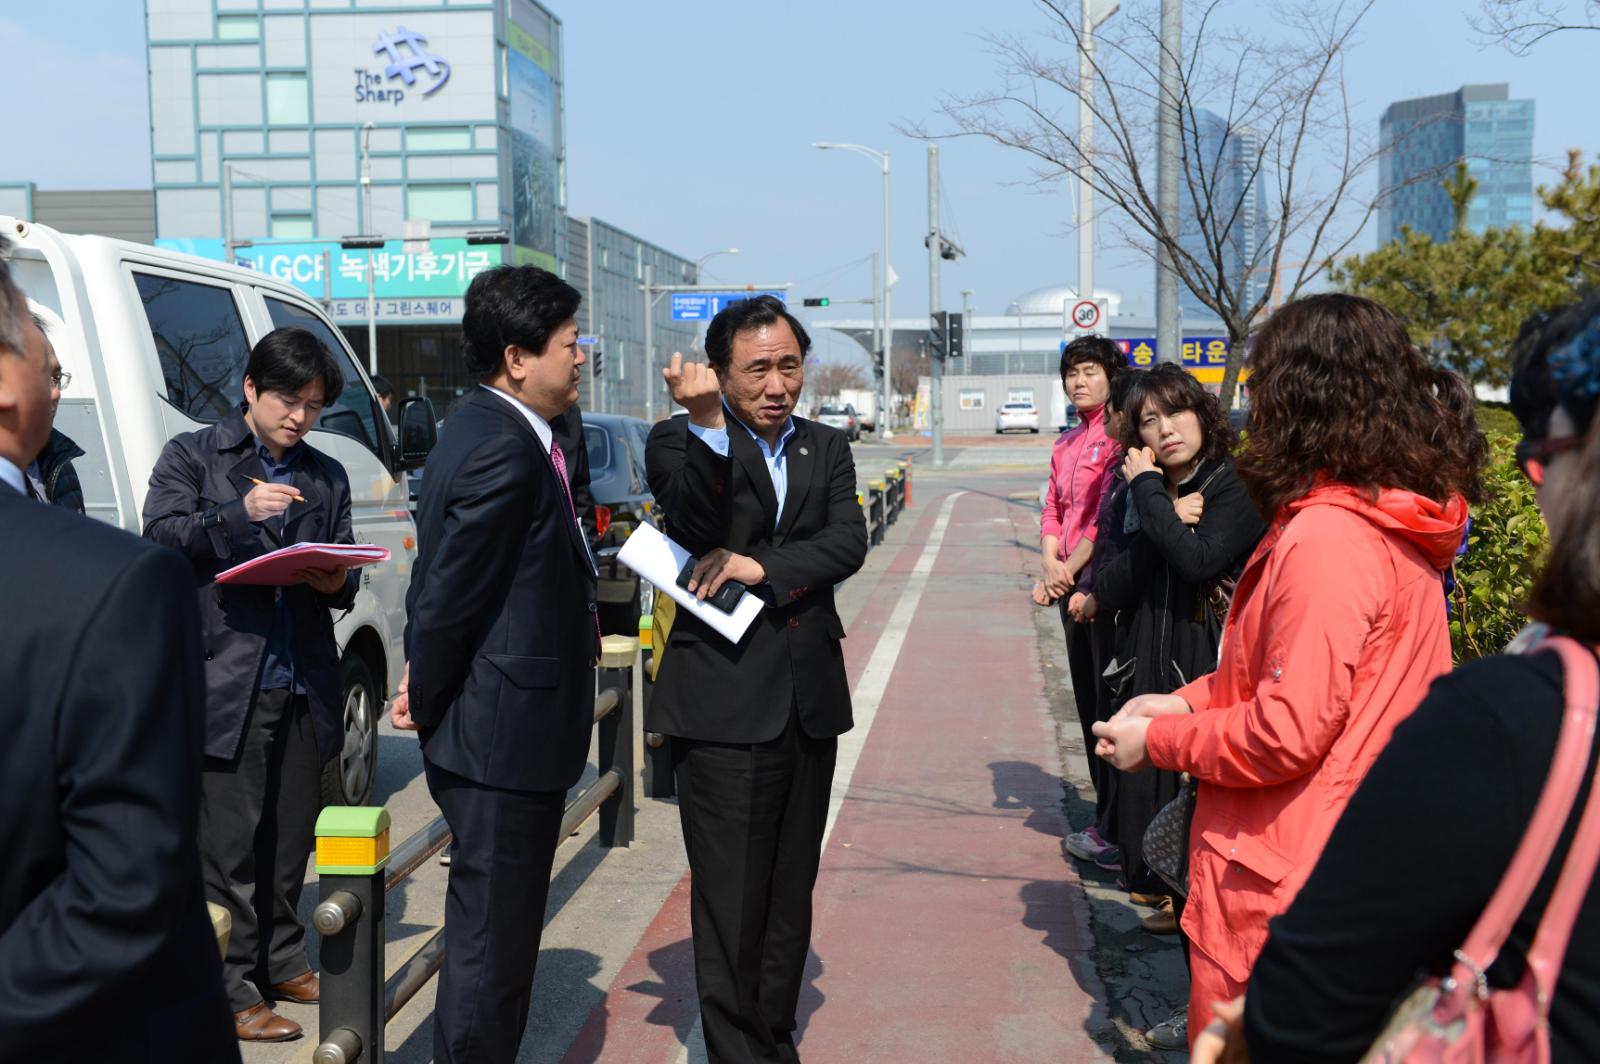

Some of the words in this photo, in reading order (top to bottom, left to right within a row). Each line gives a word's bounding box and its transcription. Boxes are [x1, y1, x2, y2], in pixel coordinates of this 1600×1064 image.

[354, 69, 381, 84] The
[355, 84, 404, 107] Sharp
[338, 251, 491, 282] 녹색기후기금
[1078, 309, 1094, 321] 30
[1132, 340, 1227, 364] 송타운
